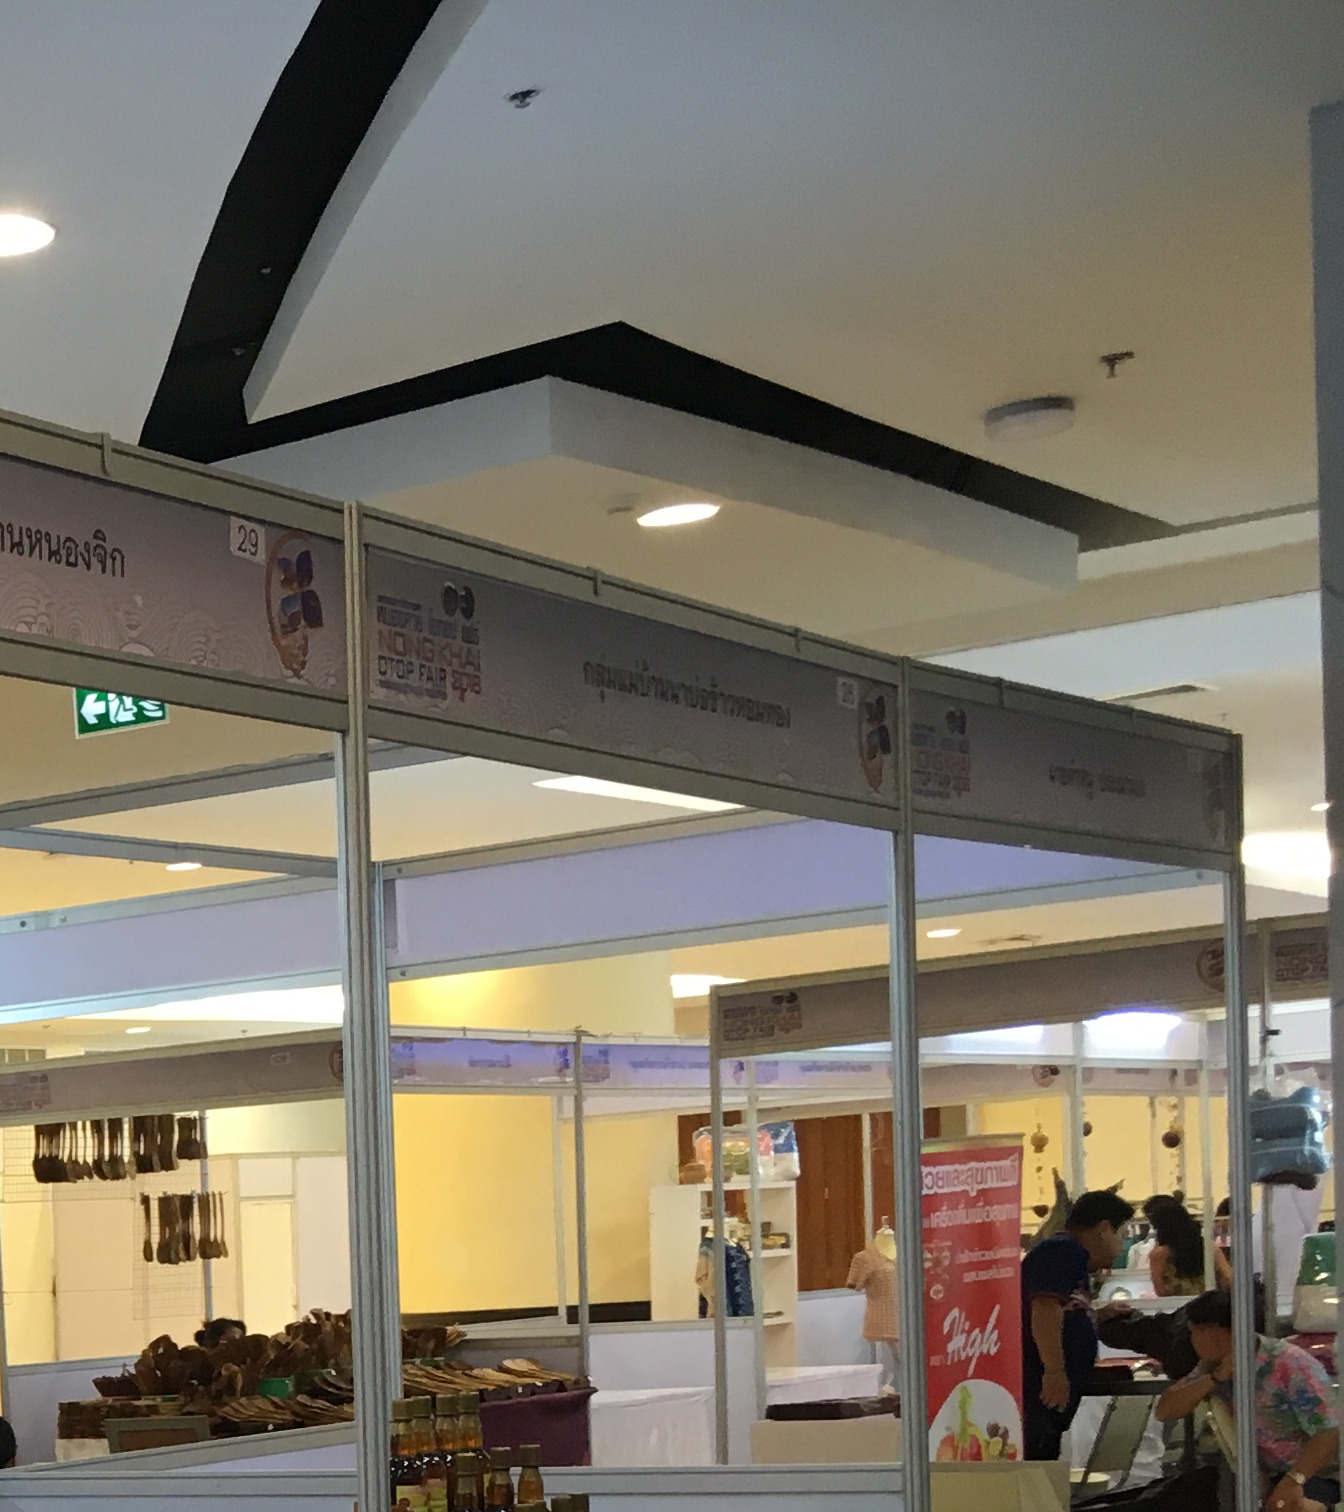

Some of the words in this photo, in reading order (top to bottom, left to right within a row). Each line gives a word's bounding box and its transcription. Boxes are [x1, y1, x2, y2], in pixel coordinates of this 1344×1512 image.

[237, 524, 260, 557] 29
[378, 654, 413, 679] OTOP
[419, 663, 447, 689] FAIR
[943, 1303, 1002, 1378] High
